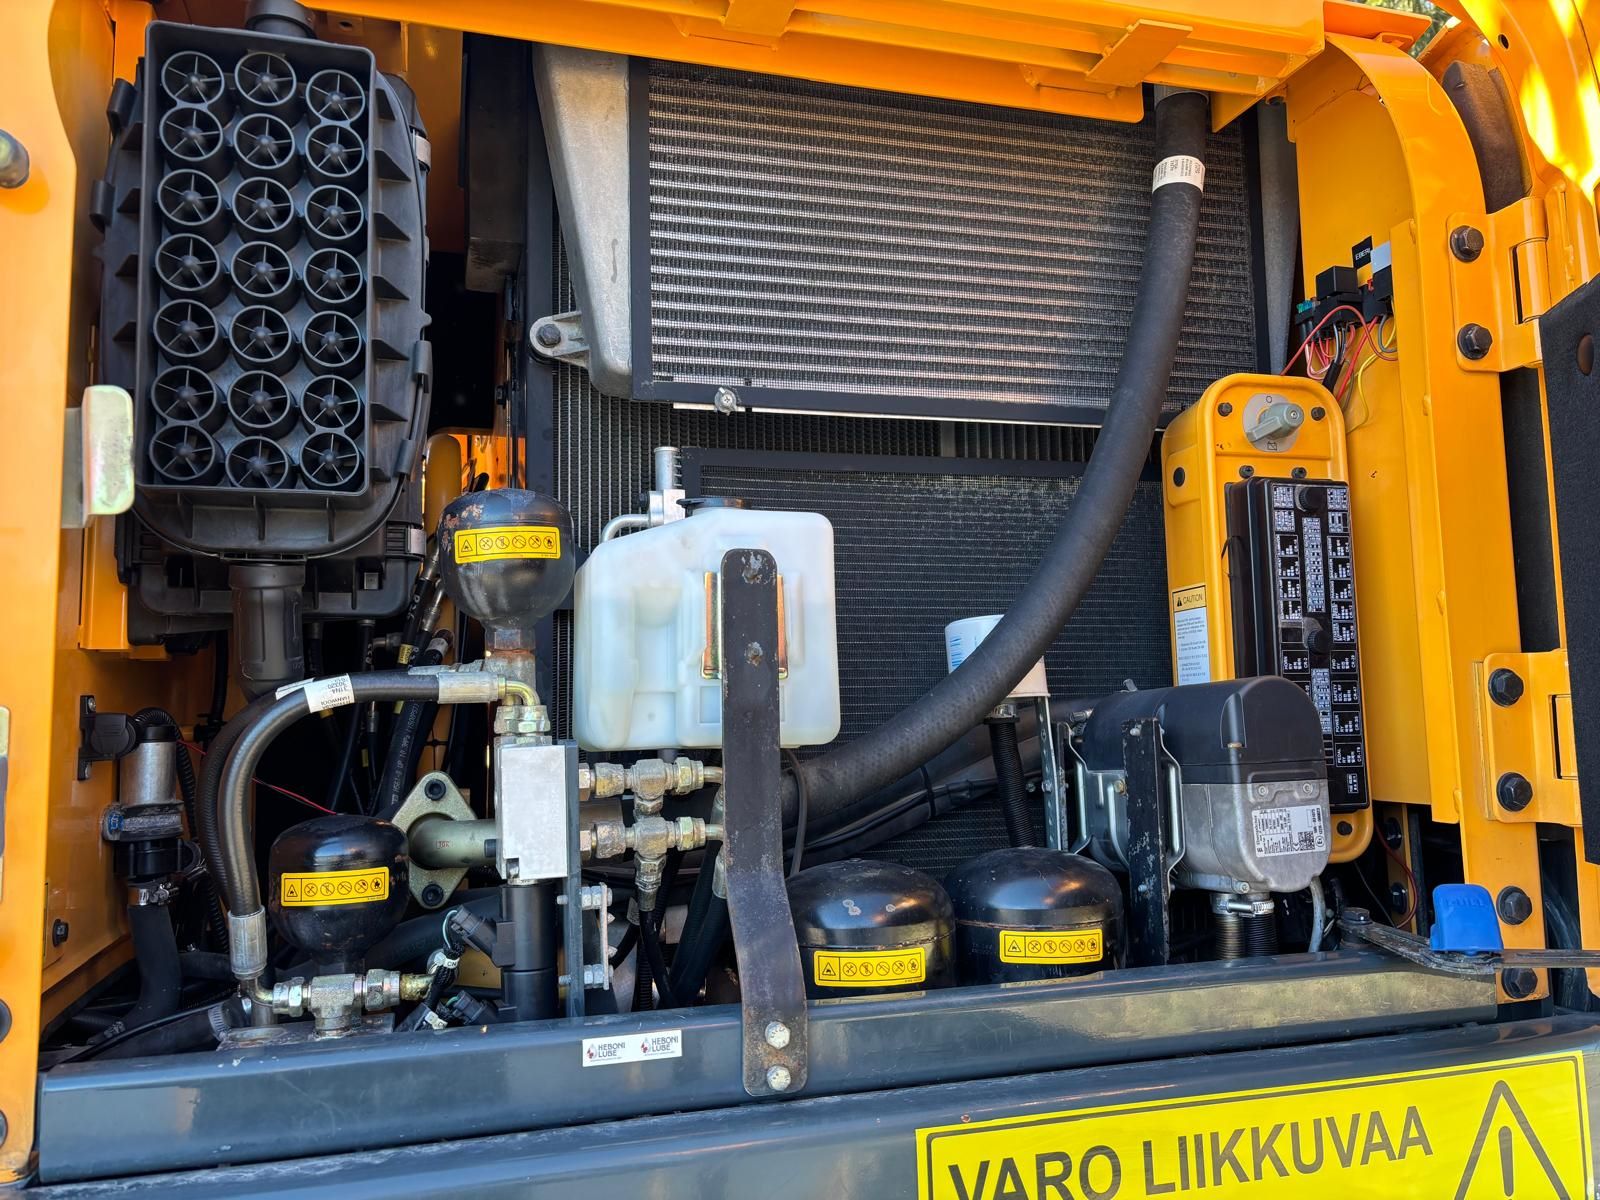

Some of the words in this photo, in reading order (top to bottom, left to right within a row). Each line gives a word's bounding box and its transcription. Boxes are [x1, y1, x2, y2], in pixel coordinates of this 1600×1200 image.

[1182, 592, 1203, 605] CAUTION
[651, 1036, 679, 1046] HEBONI
[598, 1042, 626, 1051] HEBONI
[652, 1044, 671, 1053] LUBE
[598, 1050, 617, 1058] LUBE
[948, 1143, 1121, 1200] VARO
[1143, 1105, 1434, 1196] LIIKKUVAA
